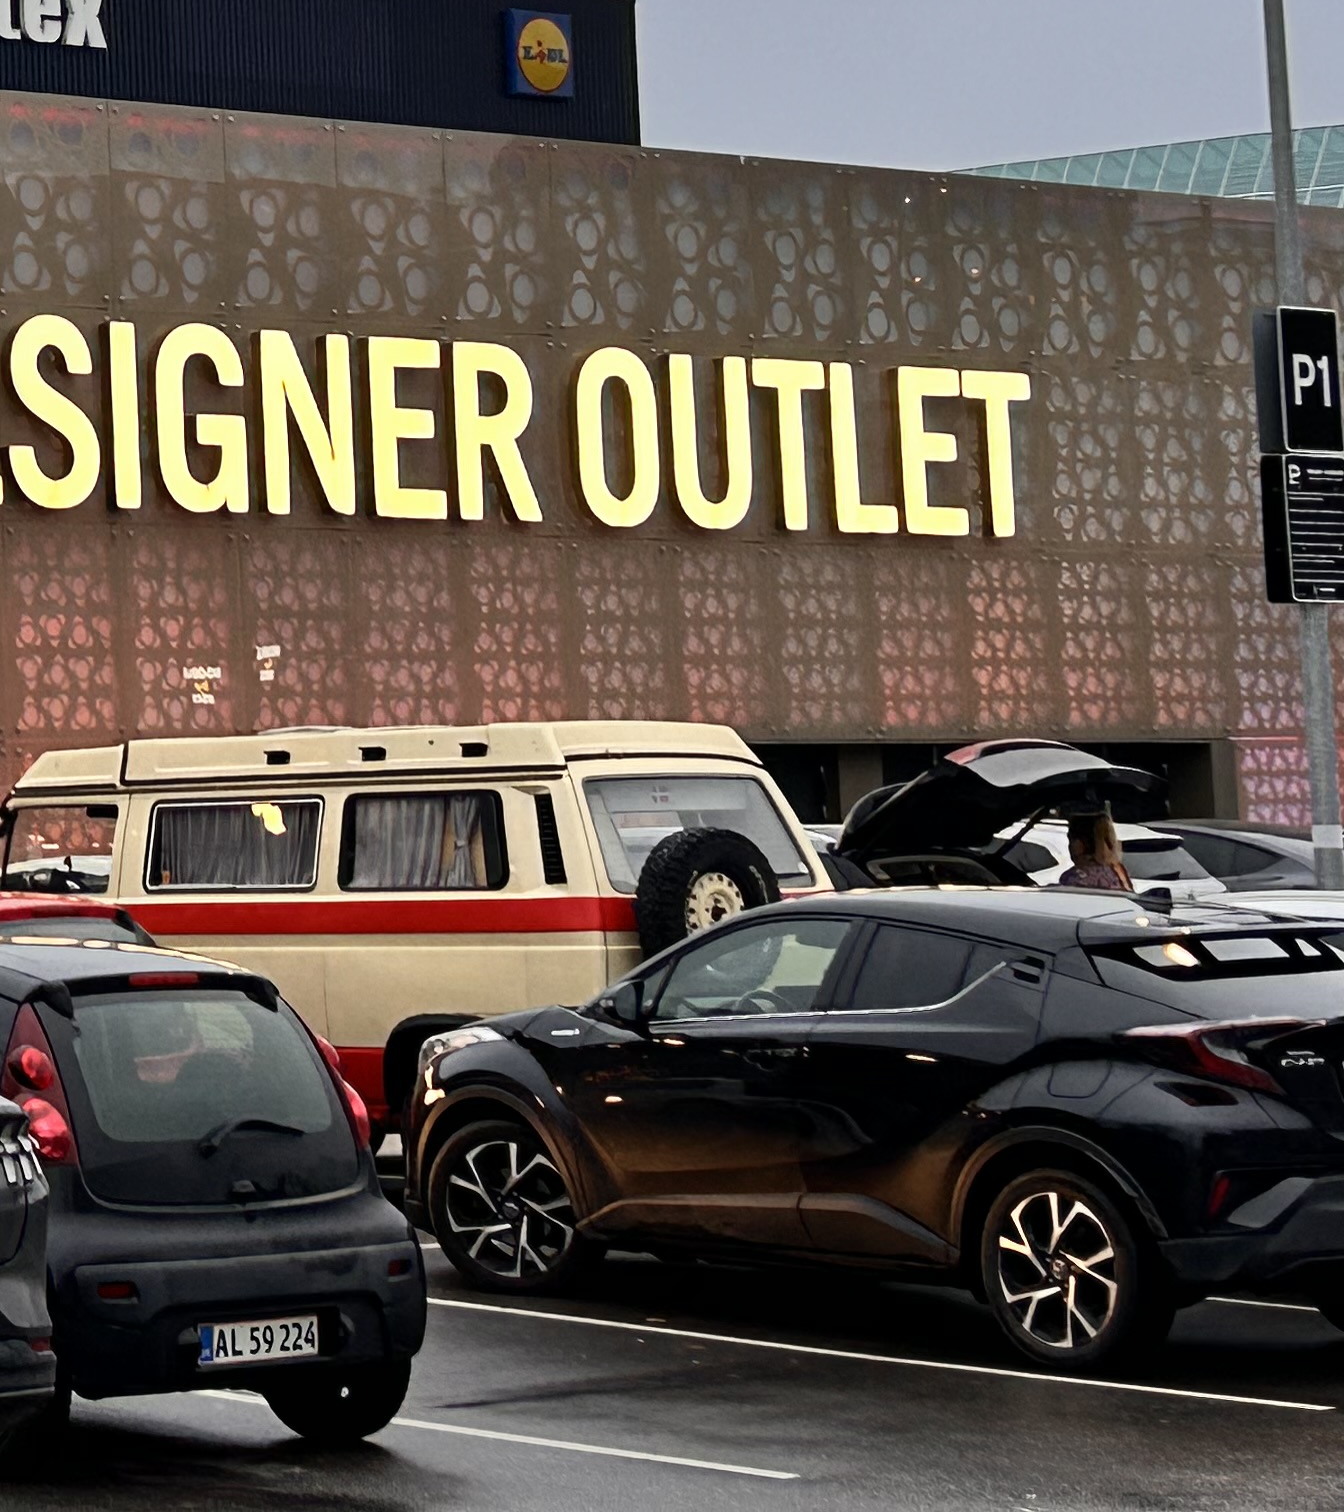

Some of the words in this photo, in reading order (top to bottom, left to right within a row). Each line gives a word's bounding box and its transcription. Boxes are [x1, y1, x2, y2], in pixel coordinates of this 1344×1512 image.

[1292, 353, 1332, 408] P1
[574, 346, 1032, 538] OUTLET
[215, 1328, 244, 1358] AL
[249, 1324, 275, 1355] 59
